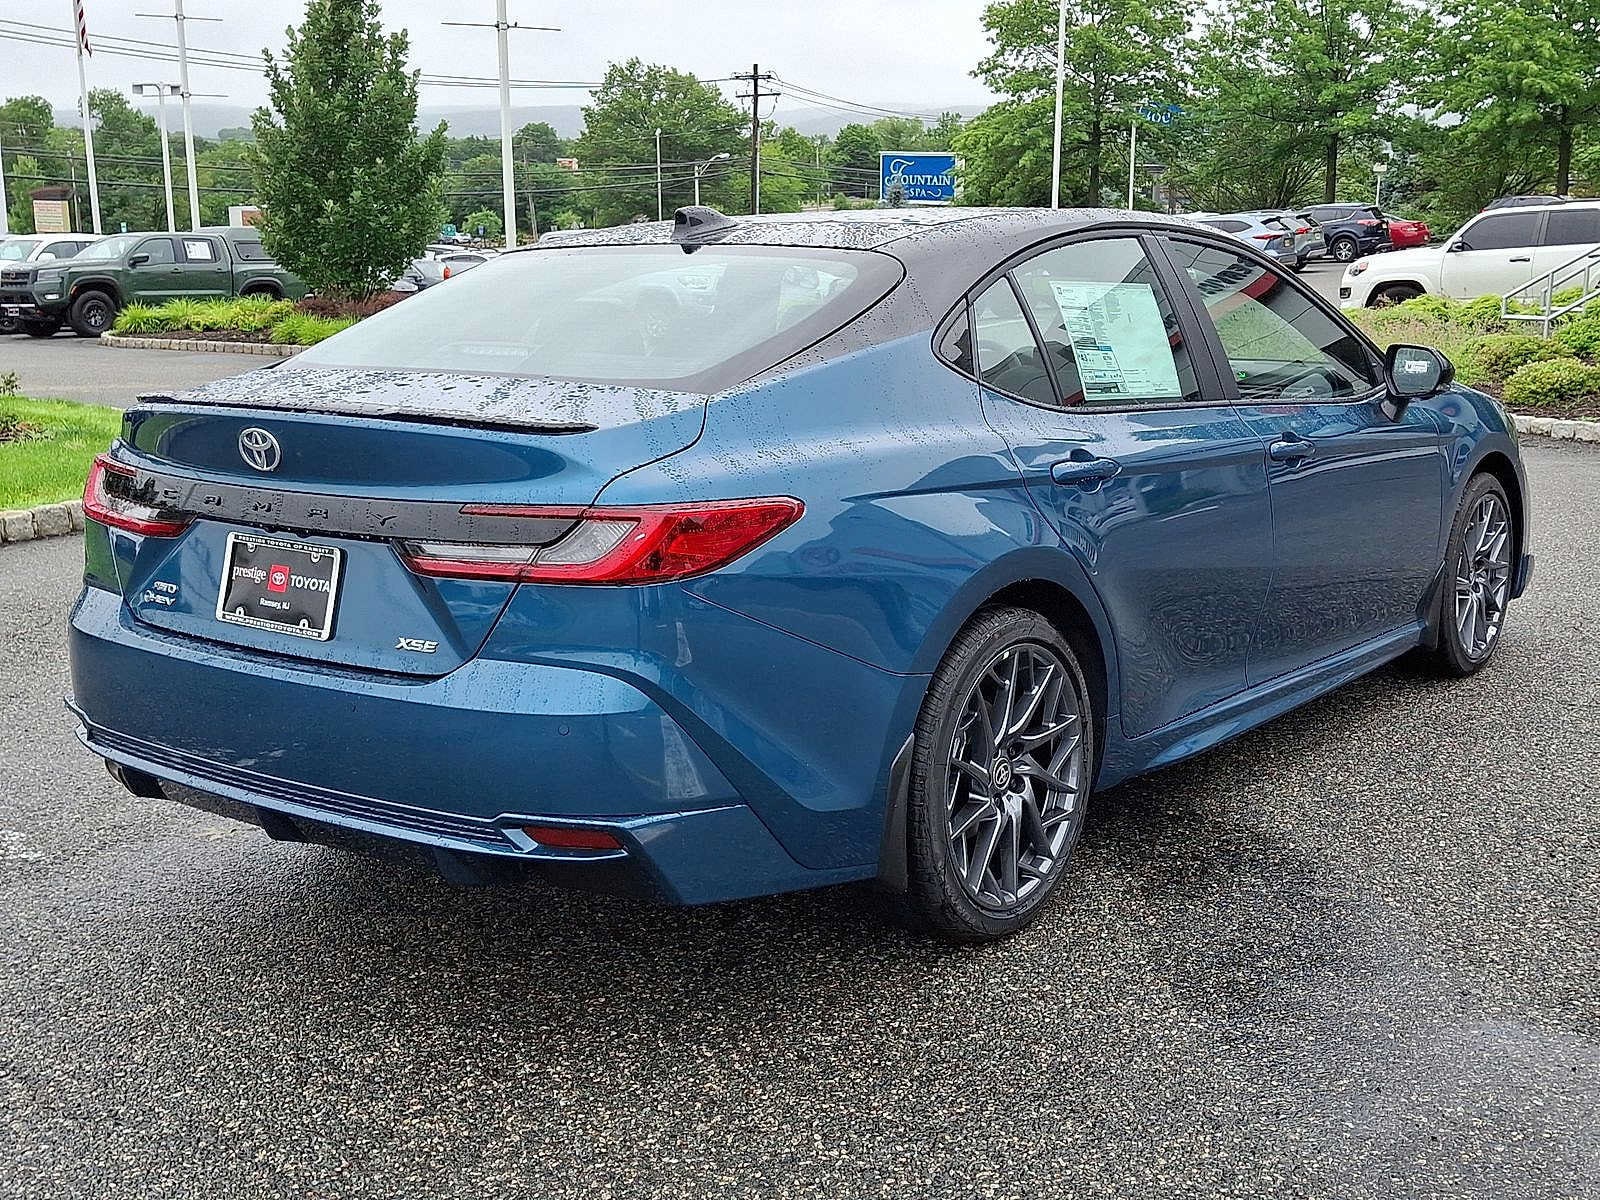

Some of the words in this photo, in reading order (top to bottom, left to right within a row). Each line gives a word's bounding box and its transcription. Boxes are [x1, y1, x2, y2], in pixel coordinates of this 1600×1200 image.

[885, 158, 951, 187] FOUNTAIN
[910, 187, 927, 197] SPA
[238, 535, 266, 544] PRESTIGE
[267, 539, 291, 548] TOYOTA
[303, 545, 330, 554] RAMSEY
[232, 565, 267, 584] prestige
[290, 574, 330, 593] TOYOTA
[282, 601, 291, 610] NJ
[395, 636, 439, 653] XSE
